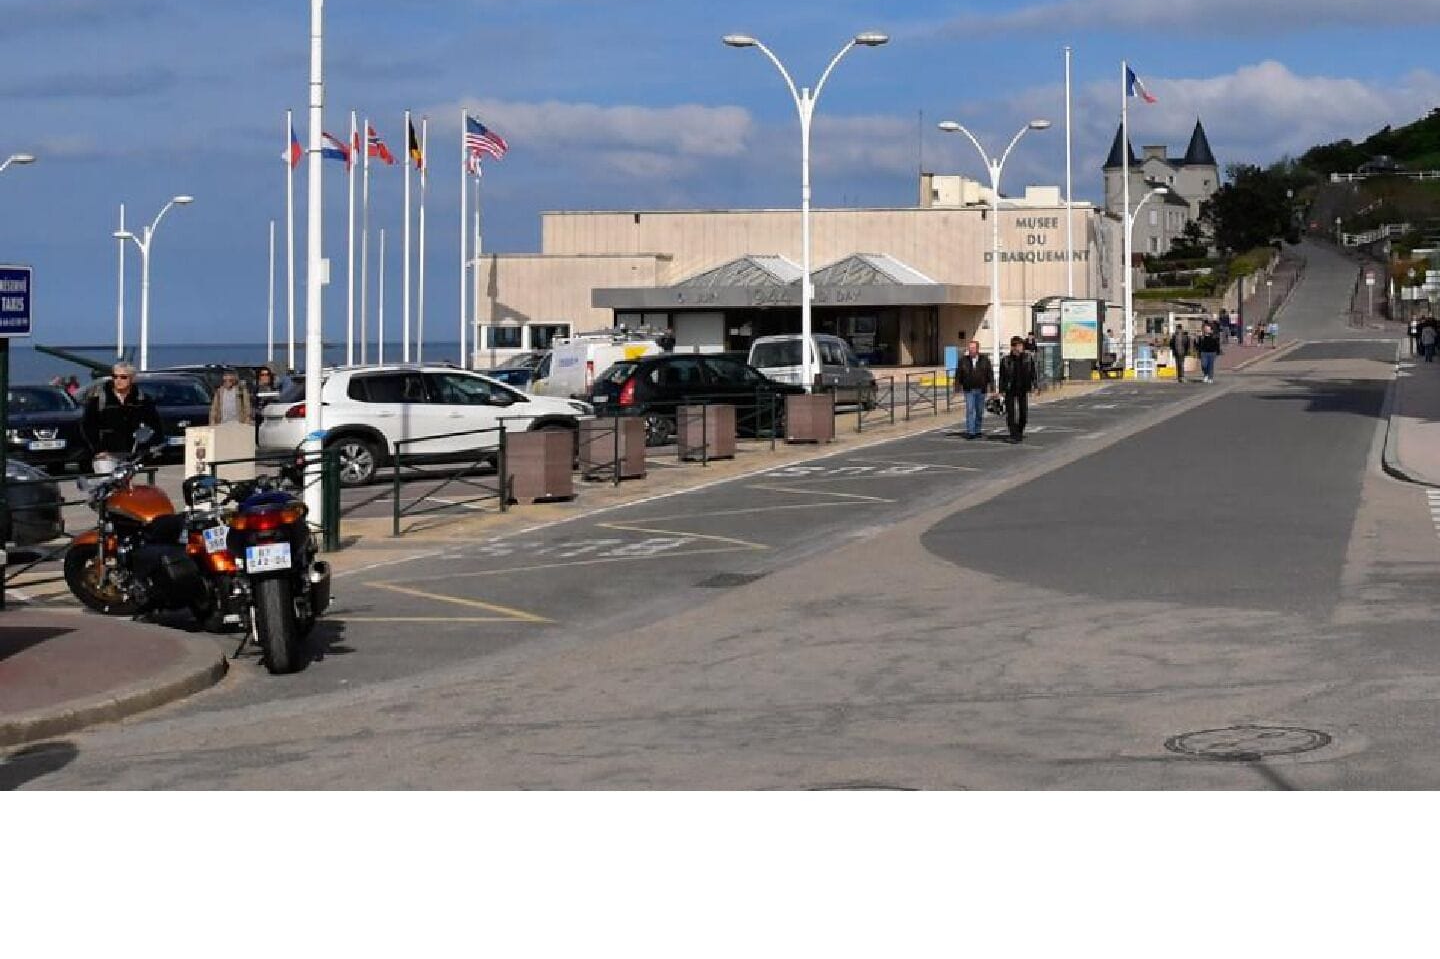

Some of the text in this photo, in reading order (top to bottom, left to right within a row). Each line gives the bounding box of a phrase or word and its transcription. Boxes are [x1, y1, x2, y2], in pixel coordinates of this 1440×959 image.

[1027, 234, 1047, 245] DU
[983, 249, 1090, 263] DBARQUEMNT
[2, 296, 25, 312] TAXIS
